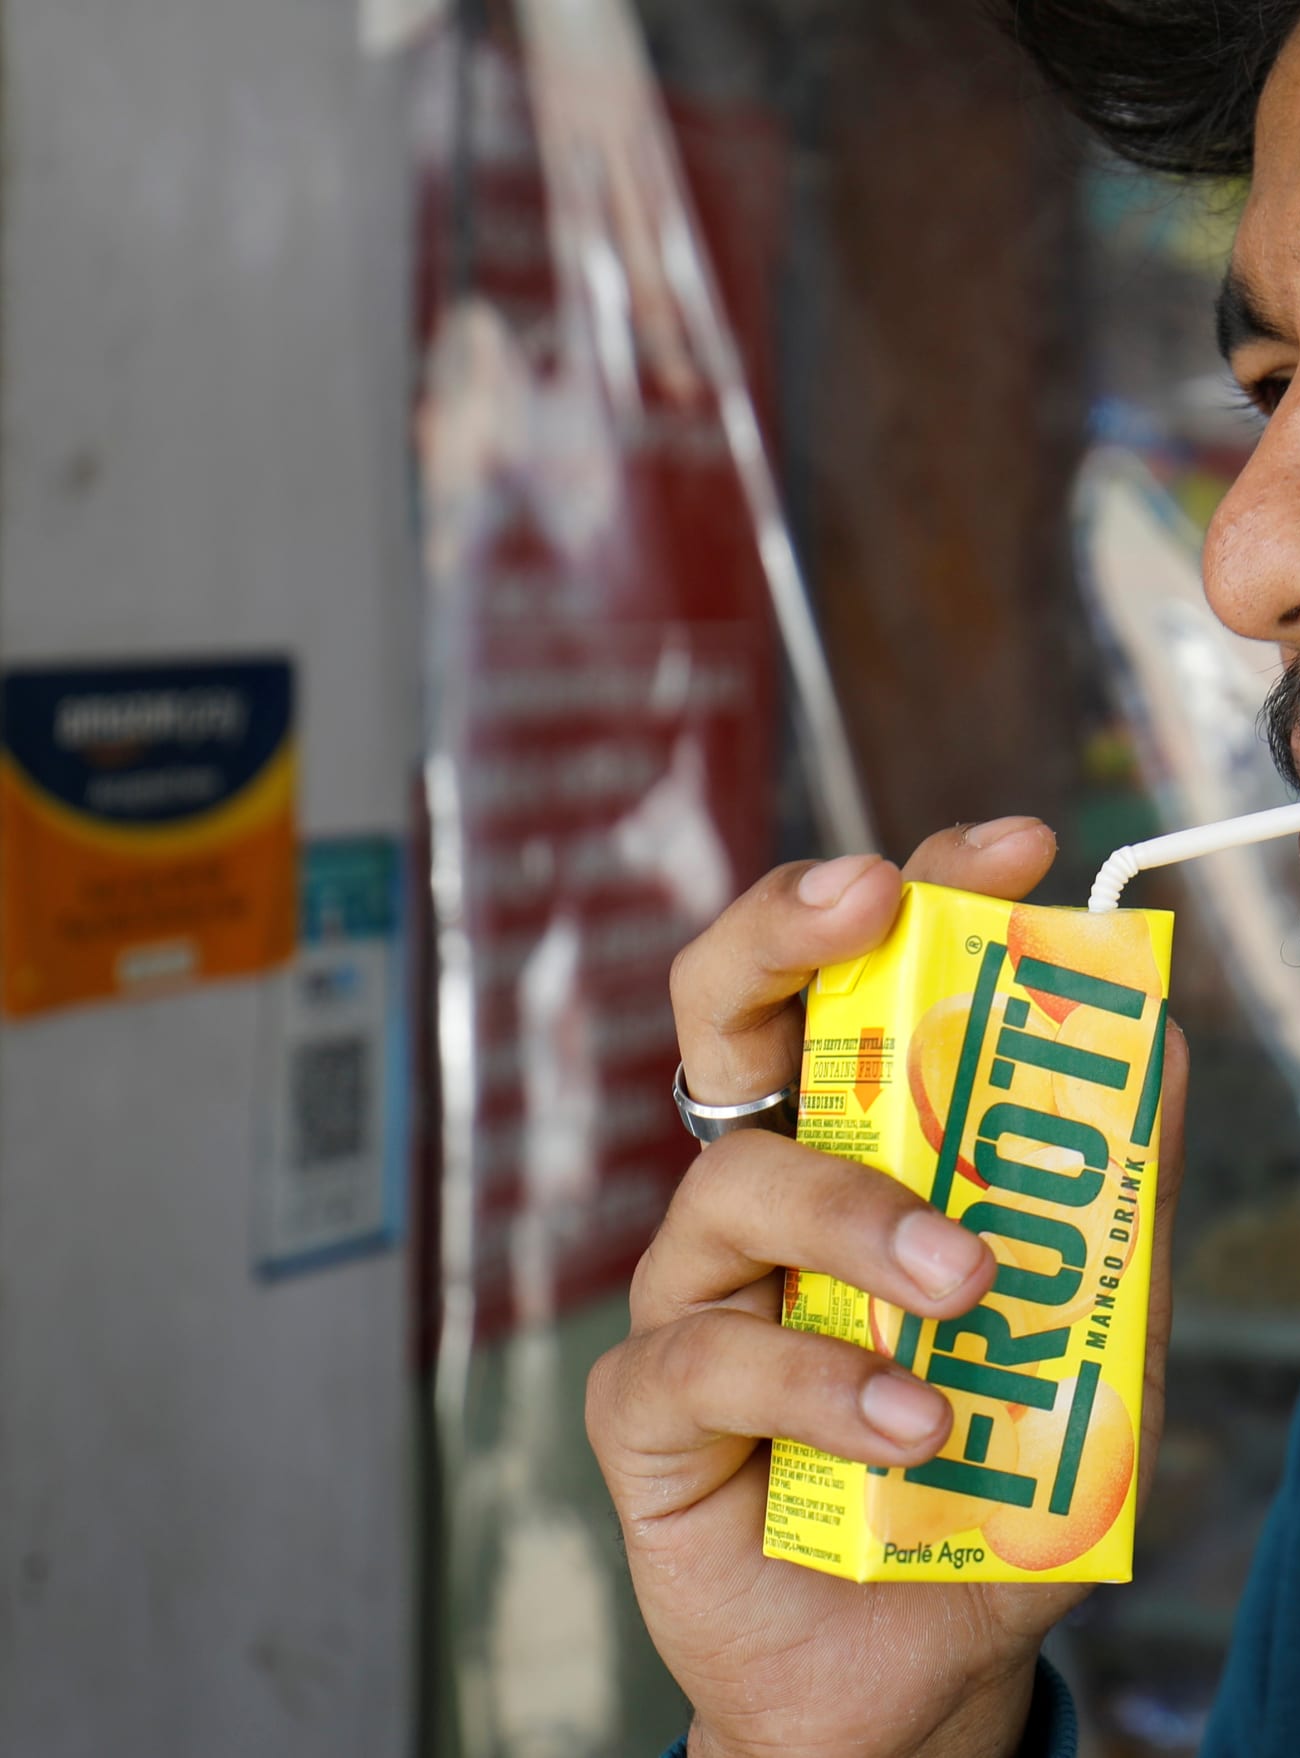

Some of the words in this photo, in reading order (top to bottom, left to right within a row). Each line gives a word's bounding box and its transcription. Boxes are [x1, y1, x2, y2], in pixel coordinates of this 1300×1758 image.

[823, 1038, 842, 1050] SERVE
[841, 1038, 859, 1050] FRUIT
[859, 1037, 895, 1050] BEVERAGE
[813, 1061, 856, 1078] CONTAINS
[858, 1061, 894, 1078] FRUIT
[904, 955, 1147, 1508] FROOTI
[1086, 1257, 1126, 1350] MANGO
[1109, 1156, 1146, 1248] DRINK
[883, 1542, 932, 1564] Parlé
[937, 1541, 985, 1569] Agro
